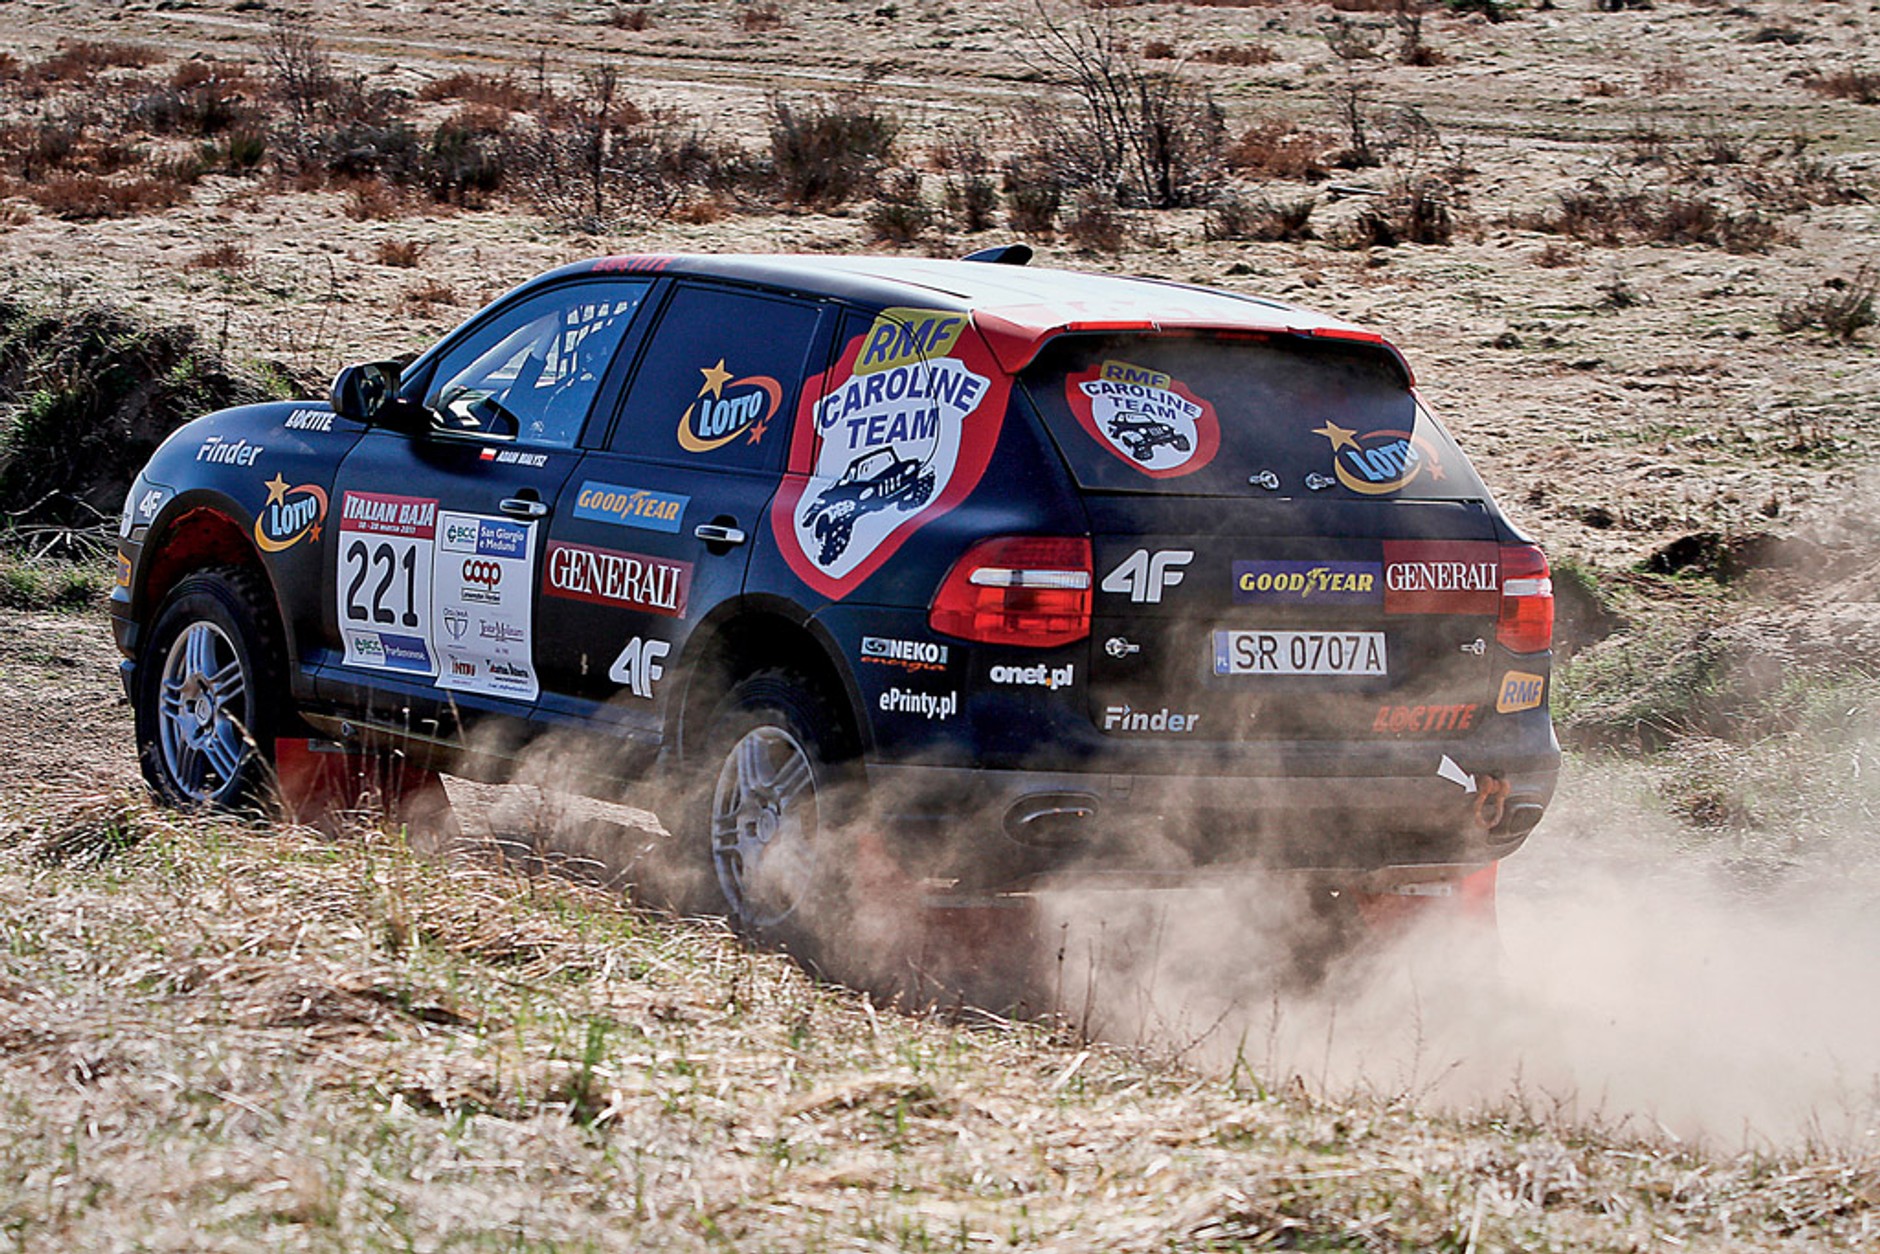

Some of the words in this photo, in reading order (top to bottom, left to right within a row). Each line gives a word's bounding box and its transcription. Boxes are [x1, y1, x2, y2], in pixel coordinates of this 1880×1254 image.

[864, 317, 961, 366] RMF
[1106, 364, 1165, 386] RMF
[699, 391, 763, 436] LOTTO
[820, 366, 981, 429] CAROLINE
[1085, 382, 1197, 418] CAROLINE
[1109, 395, 1176, 420] TEAM
[285, 409, 336, 432] LOCTITE
[847, 408, 938, 449] TEAM
[197, 436, 263, 466] Finder
[1346, 439, 1419, 481] LOTTO
[139, 490, 162, 518] 4F
[271, 495, 317, 536] LOTTO
[343, 495, 398, 523] ITALIAN
[399, 503, 436, 527] BAJA
[577, 489, 680, 521] GOODYEAR
[457, 526, 477, 539] BCC
[481, 526, 495, 538] San
[496, 528, 525, 543] Giorgio
[346, 540, 418, 627] 221
[463, 559, 502, 592] coop
[550, 547, 682, 610] GENERALI
[1101, 549, 1195, 603] 4F
[1239, 567, 1374, 598] GOODYEAR
[1386, 563, 1498, 591] GENERALI
[608, 636, 671, 698] 4F
[890, 639, 939, 663] NEKO
[1235, 635, 1278, 670] SR
[1291, 636, 1381, 671] 0707A
[989, 664, 1073, 690] onet.pl
[1502, 680, 1541, 705] RMF
[879, 687, 957, 720] ePrinty.pl
[1104, 705, 1199, 732] Finder
[1372, 704, 1477, 732] LOCTITE
